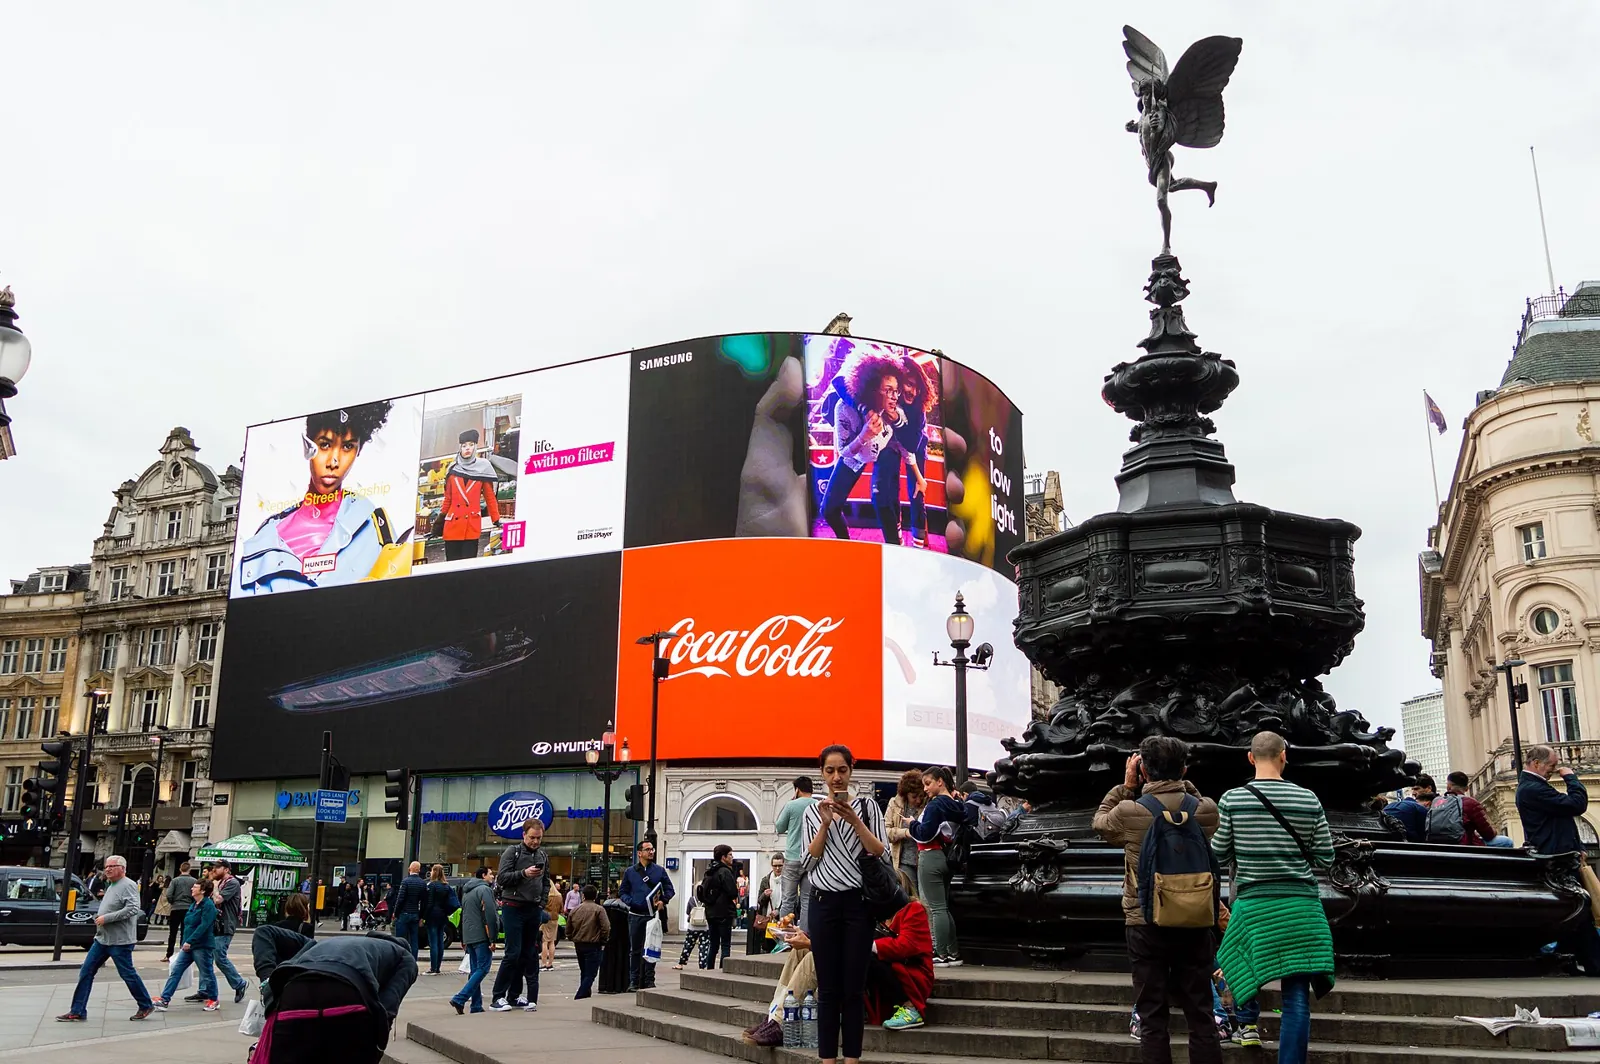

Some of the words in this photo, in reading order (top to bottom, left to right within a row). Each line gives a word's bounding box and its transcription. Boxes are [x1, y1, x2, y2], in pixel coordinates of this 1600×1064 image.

[639, 351, 693, 371] SAMSUNG
[534, 440, 554, 453] life.
[988, 426, 1003, 455] to
[532, 455, 558, 469] with
[560, 454, 575, 467] no
[578, 447, 609, 463] filter.
[989, 460, 1012, 496] low
[303, 489, 339, 507] Street
[342, 481, 391, 500] Flagship
[991, 494, 1018, 536] light.
[304, 559, 334, 568] HUNTER
[652, 615, 846, 681] Coca-Cola
[292, 789, 360, 807] BARS
[422, 810, 479, 824] pharmacy
[493, 798, 544, 831] Boots
[257, 863, 297, 891] WICKED
